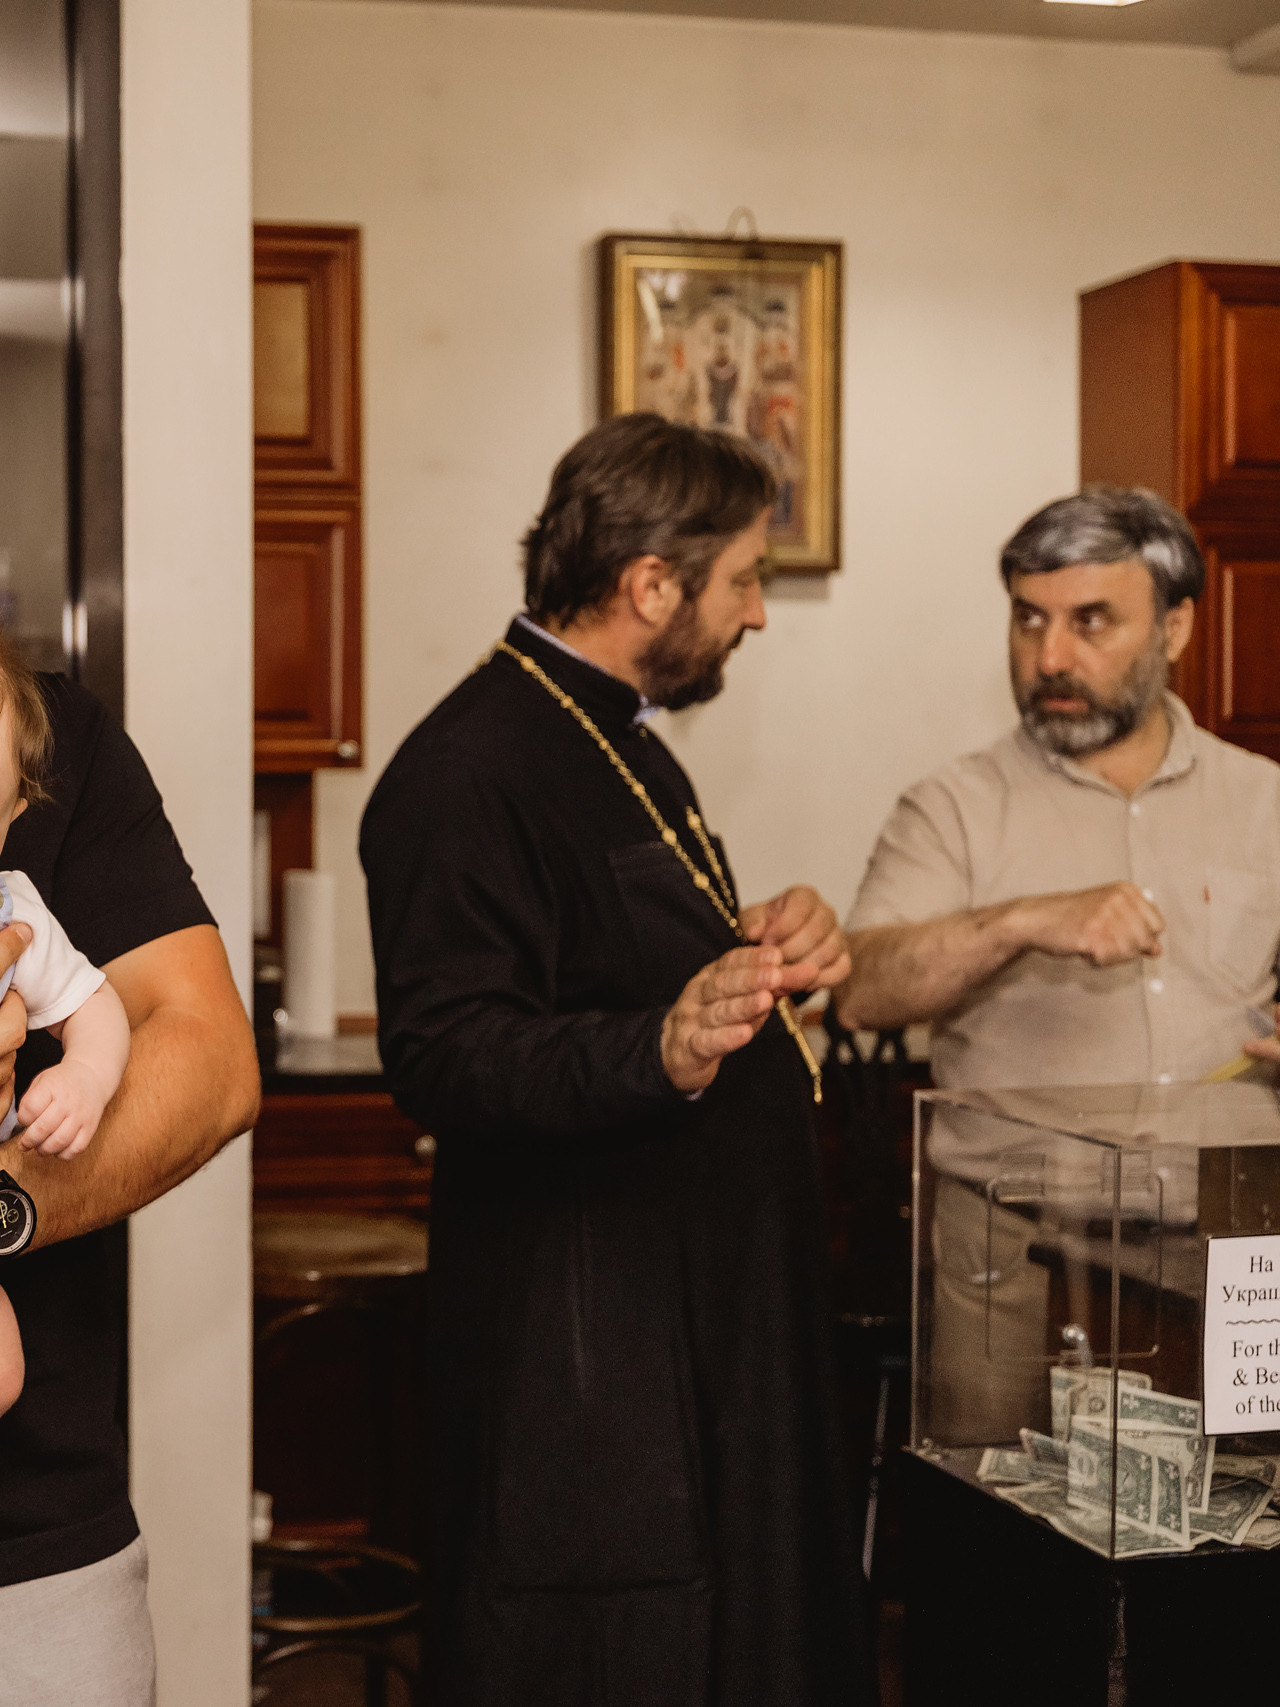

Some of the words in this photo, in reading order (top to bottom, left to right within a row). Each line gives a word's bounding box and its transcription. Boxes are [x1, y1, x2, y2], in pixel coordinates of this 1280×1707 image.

[1249, 1256, 1273, 1273] На
[1232, 1340, 1263, 1358] For
[1232, 1368, 1248, 1386] &
[1256, 1367, 1280, 1385] Be
[1235, 1395, 1256, 1415] of
